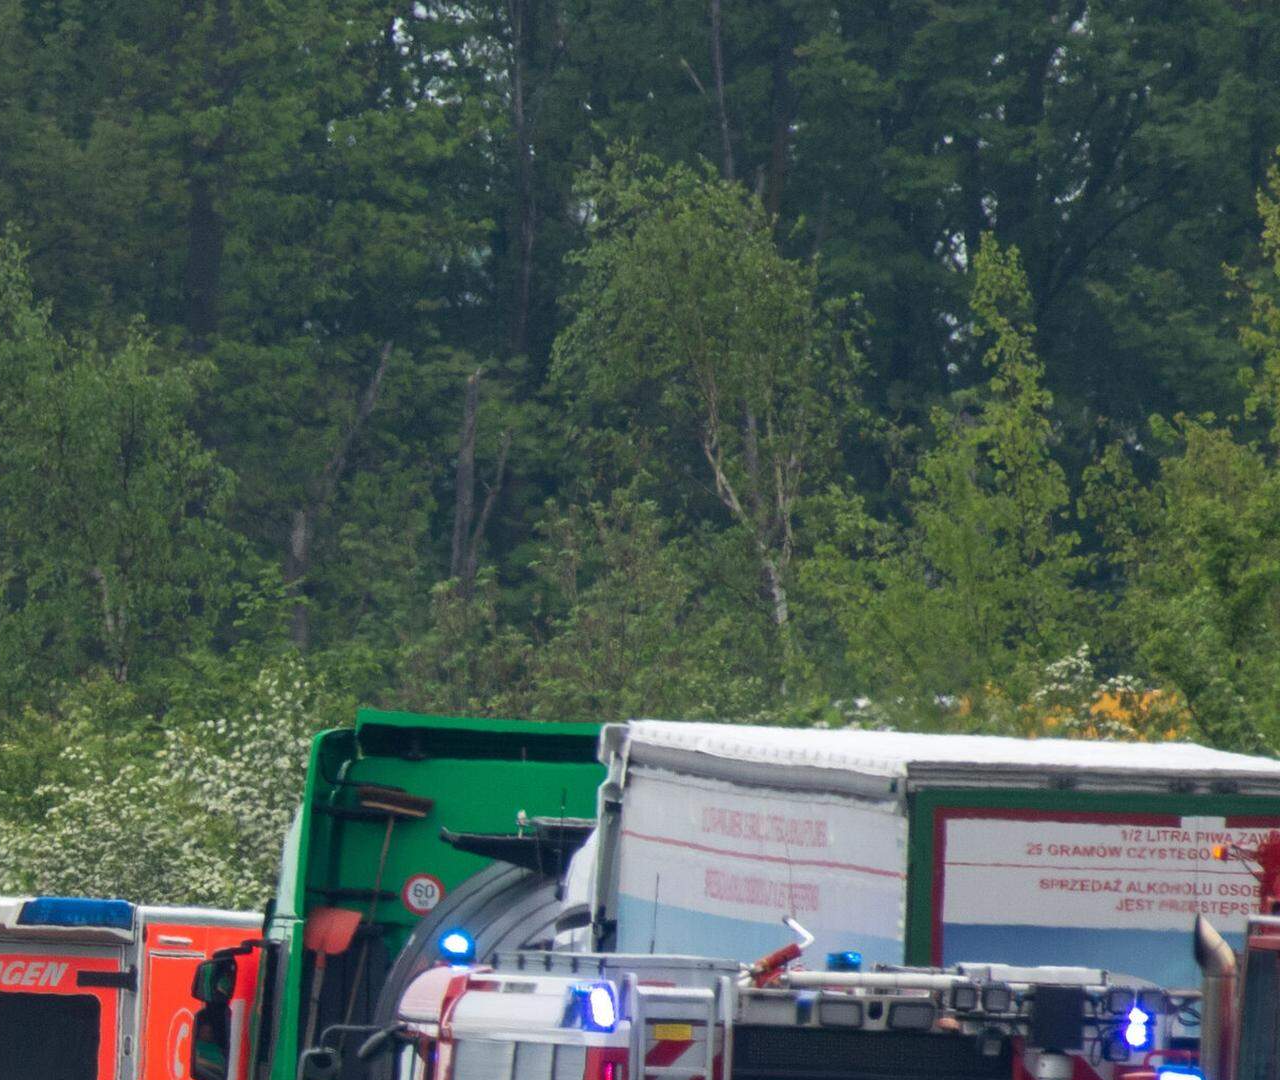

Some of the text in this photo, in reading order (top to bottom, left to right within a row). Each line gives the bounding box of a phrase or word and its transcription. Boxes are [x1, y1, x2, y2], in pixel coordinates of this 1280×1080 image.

[1146, 830, 1193, 844] LITRA
[1126, 846, 1211, 861] CZYSTEGO
[414, 884, 436, 899] 60
[1115, 899, 1155, 913] JEST
